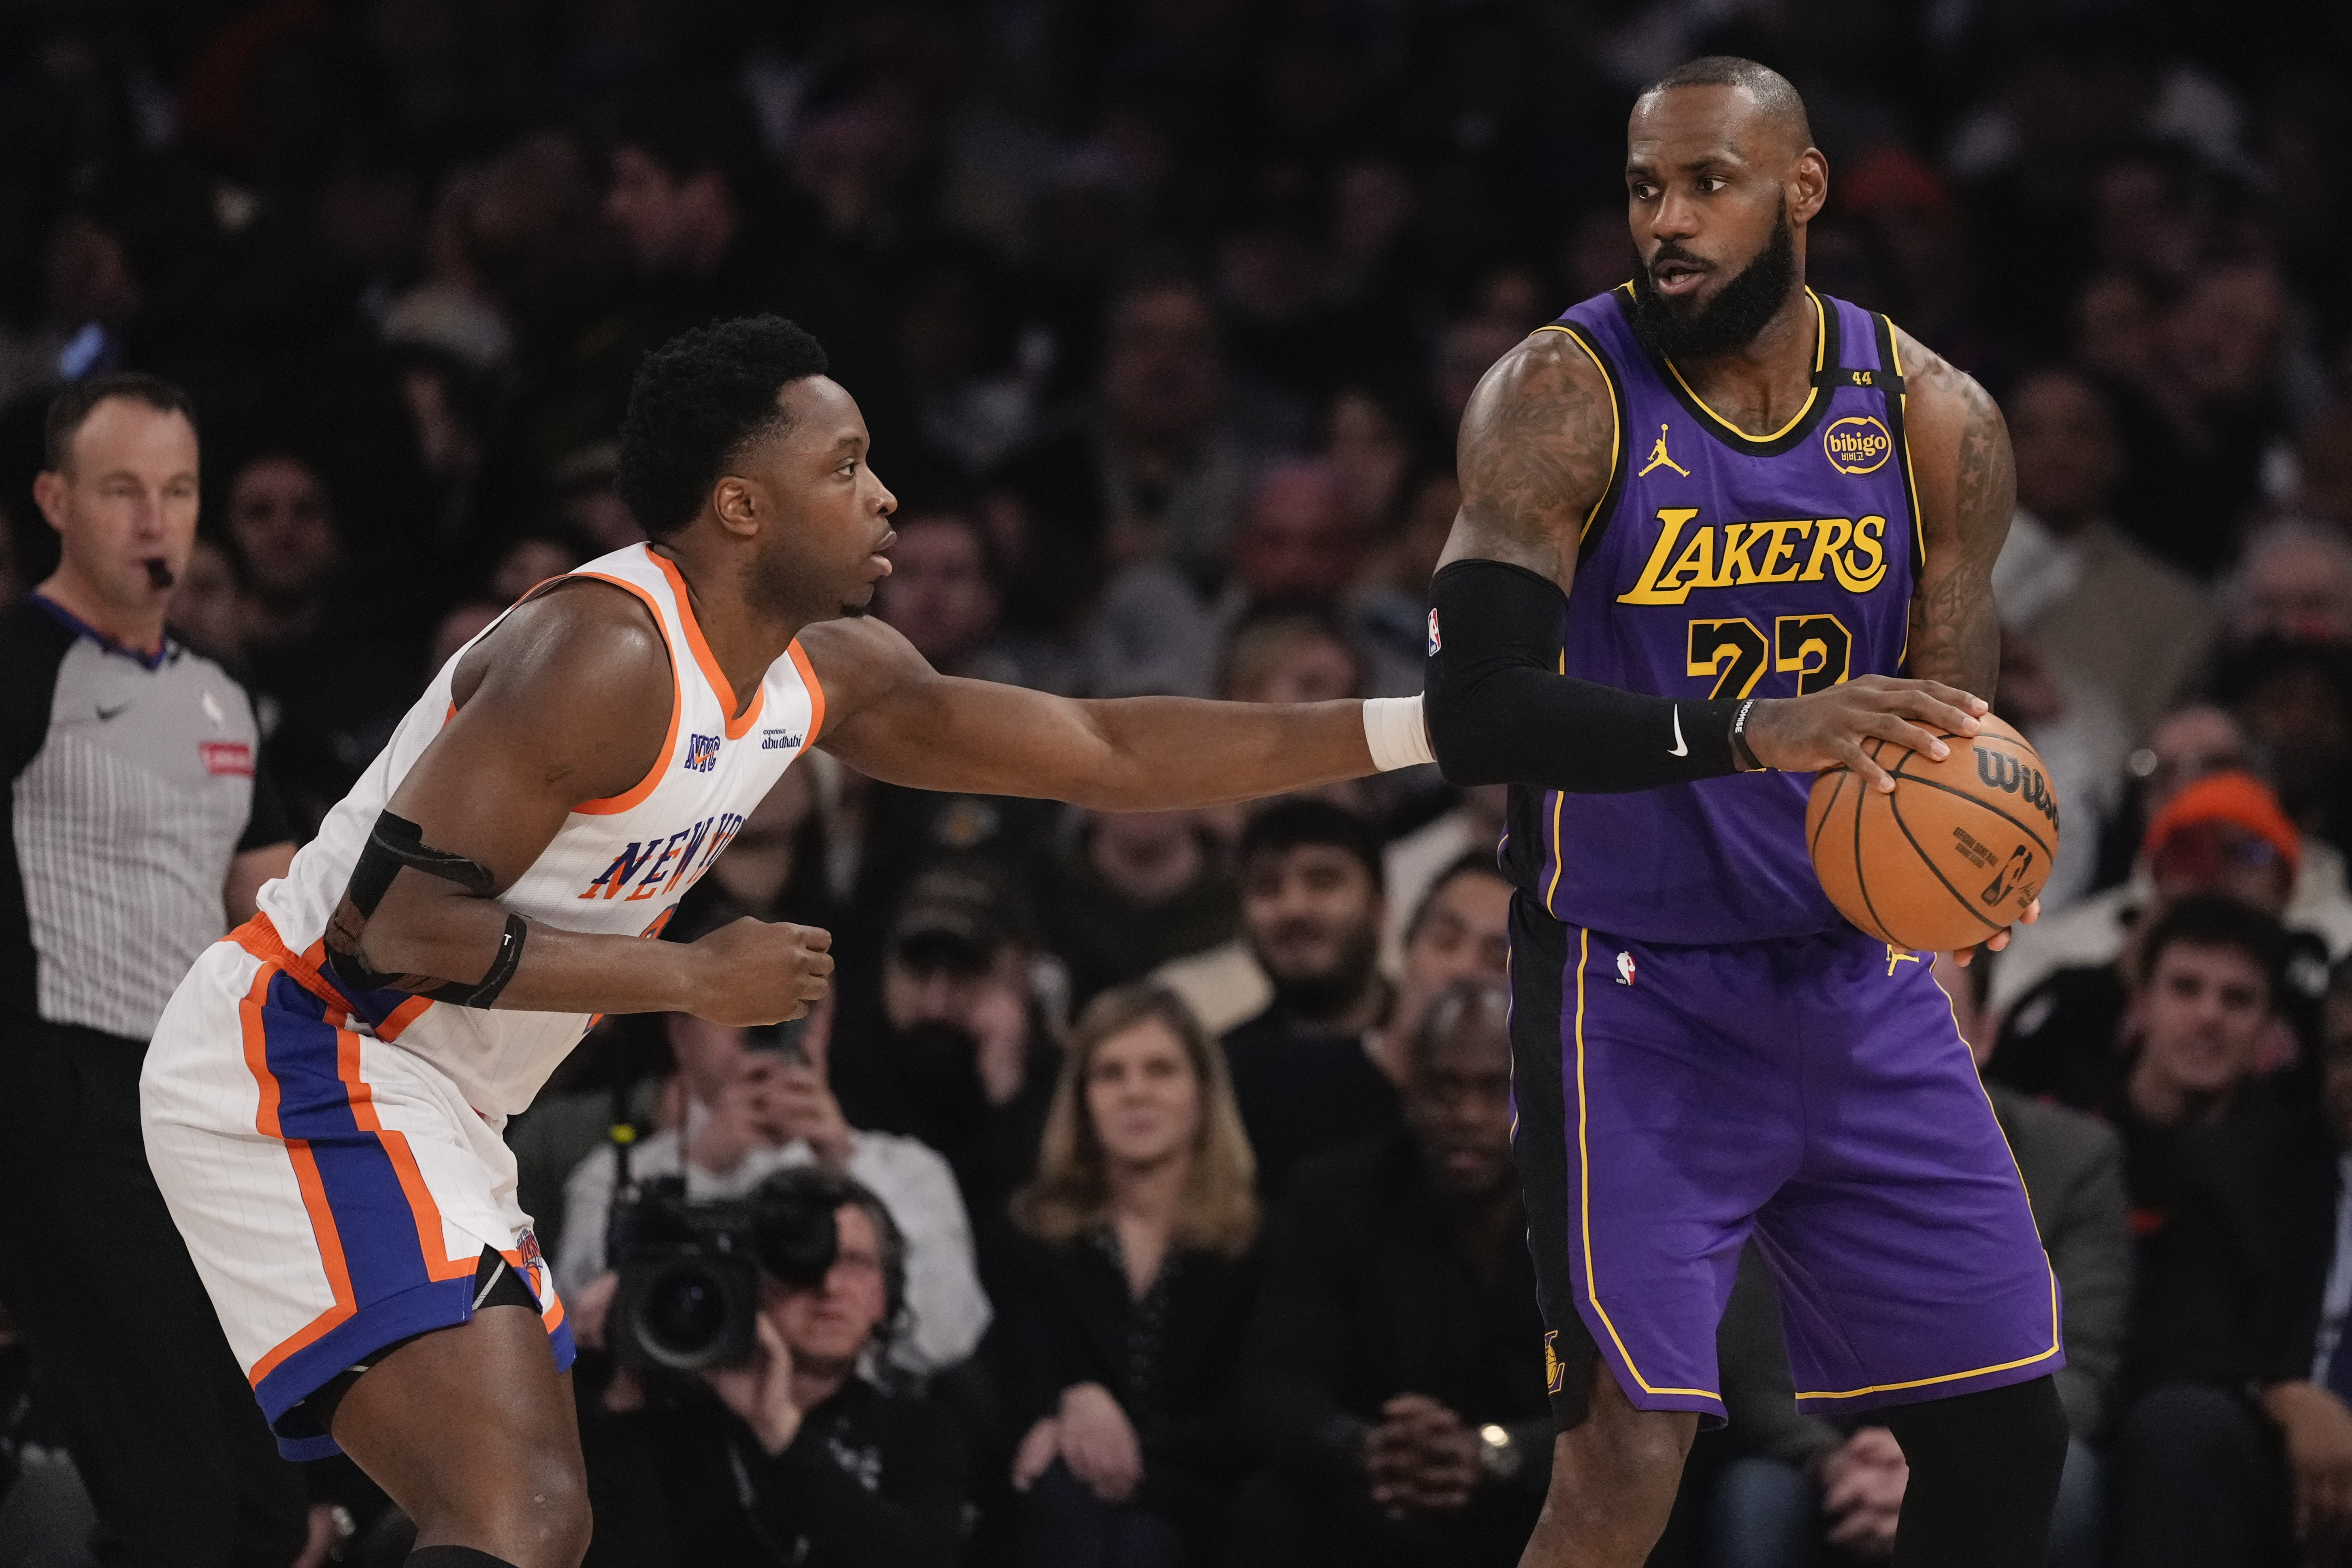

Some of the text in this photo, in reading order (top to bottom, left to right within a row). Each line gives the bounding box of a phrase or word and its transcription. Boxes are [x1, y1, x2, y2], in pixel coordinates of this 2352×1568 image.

[1852, 371, 1872, 385] 44
[1829, 432, 1886, 456] bibigo
[1841, 452, 1864, 462] 비비고
[1616, 506, 1888, 605] LAKERS
[1735, 701, 1753, 733] PROMISE
[684, 734, 720, 772] NYC
[762, 734, 802, 749] abu dhabi
[1973, 746, 2060, 832] Wilso
[578, 813, 746, 901] NEW YO
